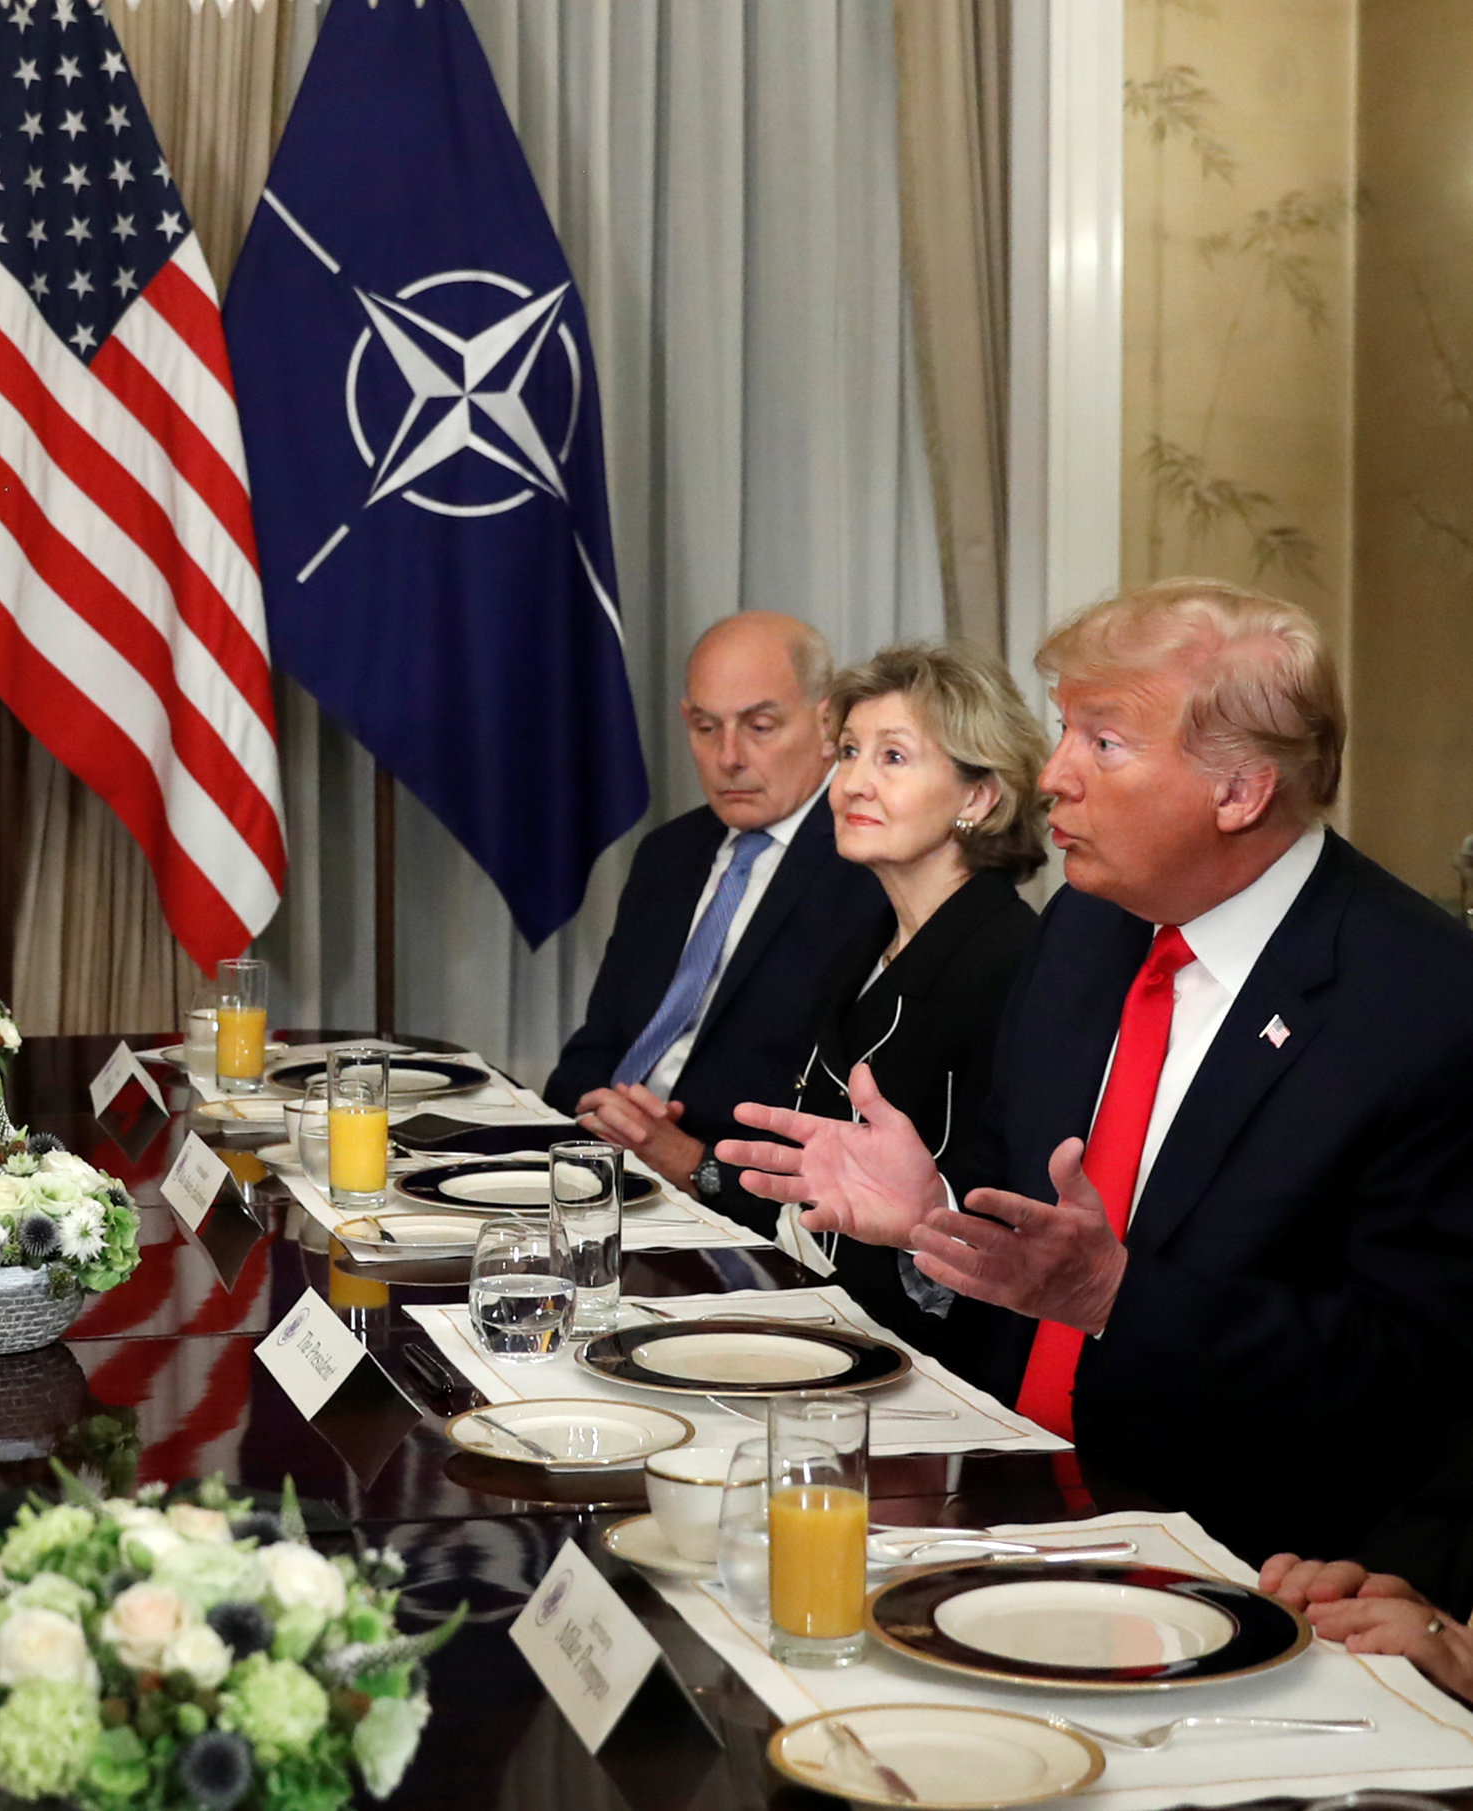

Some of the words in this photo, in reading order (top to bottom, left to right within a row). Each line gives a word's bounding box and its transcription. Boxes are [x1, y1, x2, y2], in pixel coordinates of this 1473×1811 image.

[296, 1330, 314, 1354] The
[305, 1341, 337, 1381] President
[554, 1618, 583, 1661] Mike
